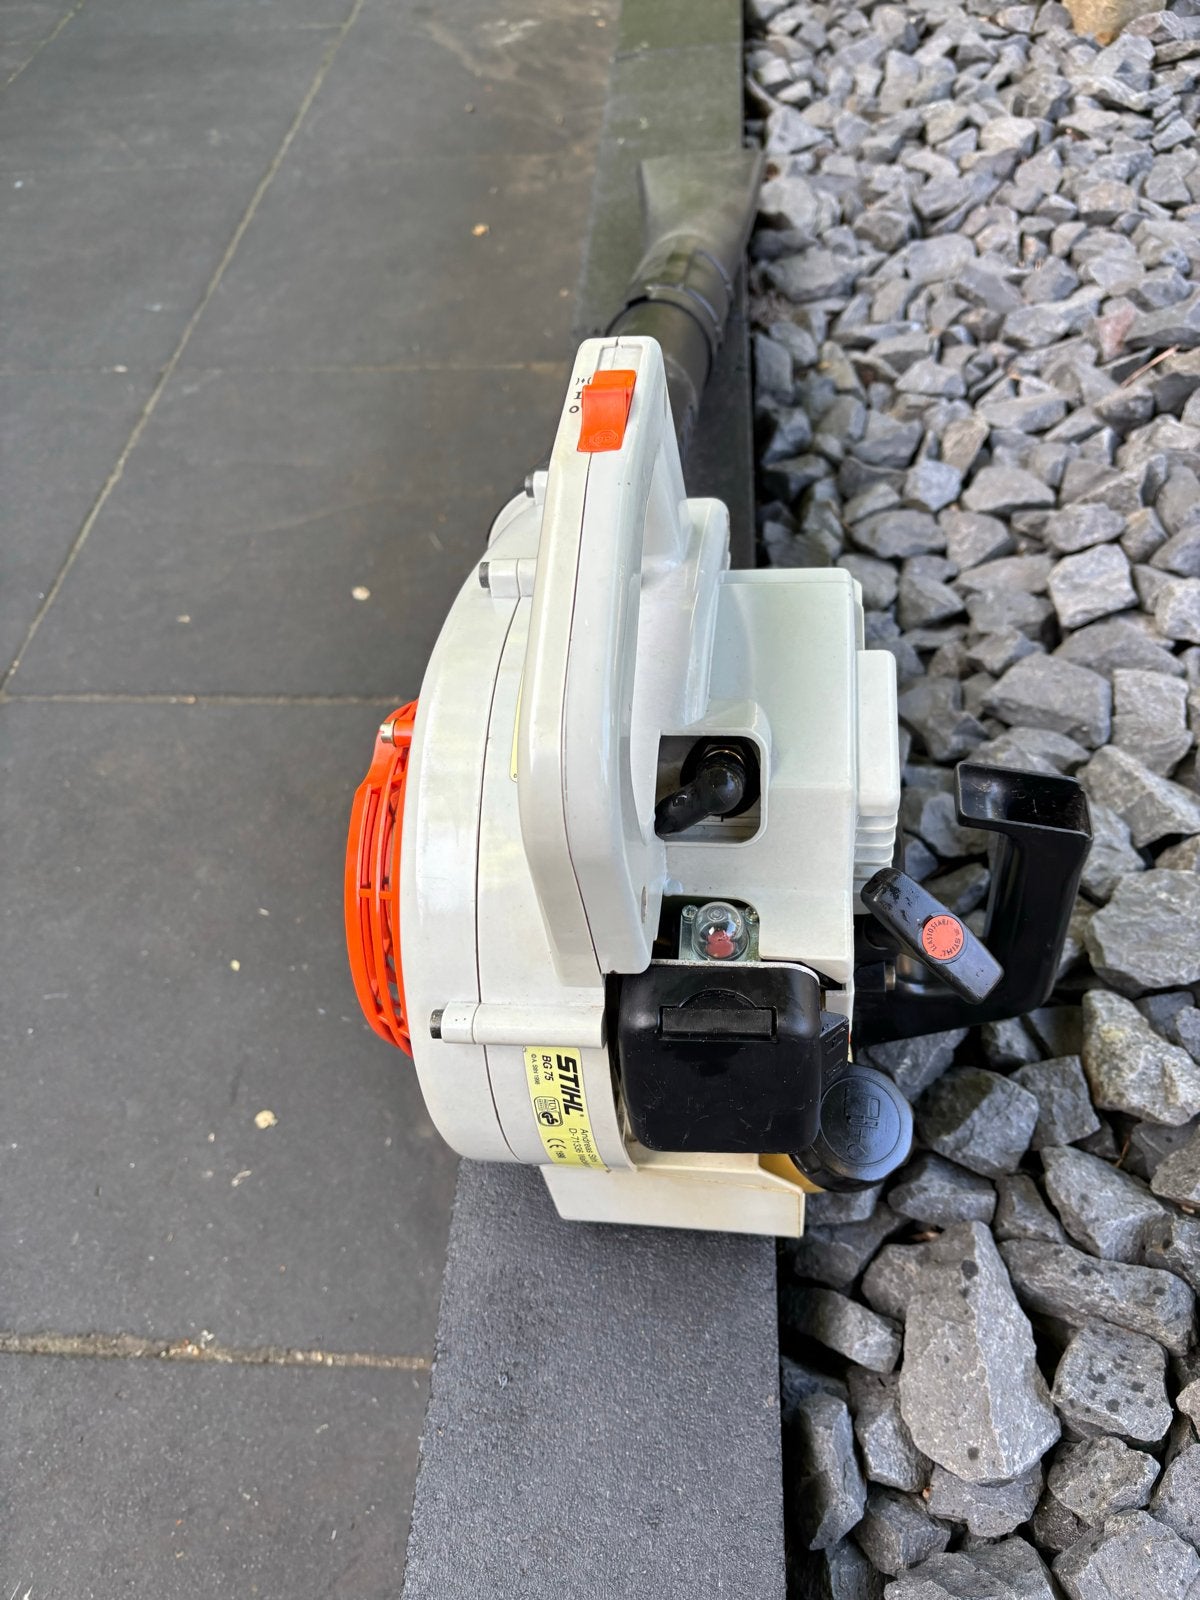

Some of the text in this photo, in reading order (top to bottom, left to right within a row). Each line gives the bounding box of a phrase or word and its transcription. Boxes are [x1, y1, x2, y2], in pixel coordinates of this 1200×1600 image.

[541, 1055, 554, 1082] BG 75
[556, 1054, 584, 1116] STIHL
